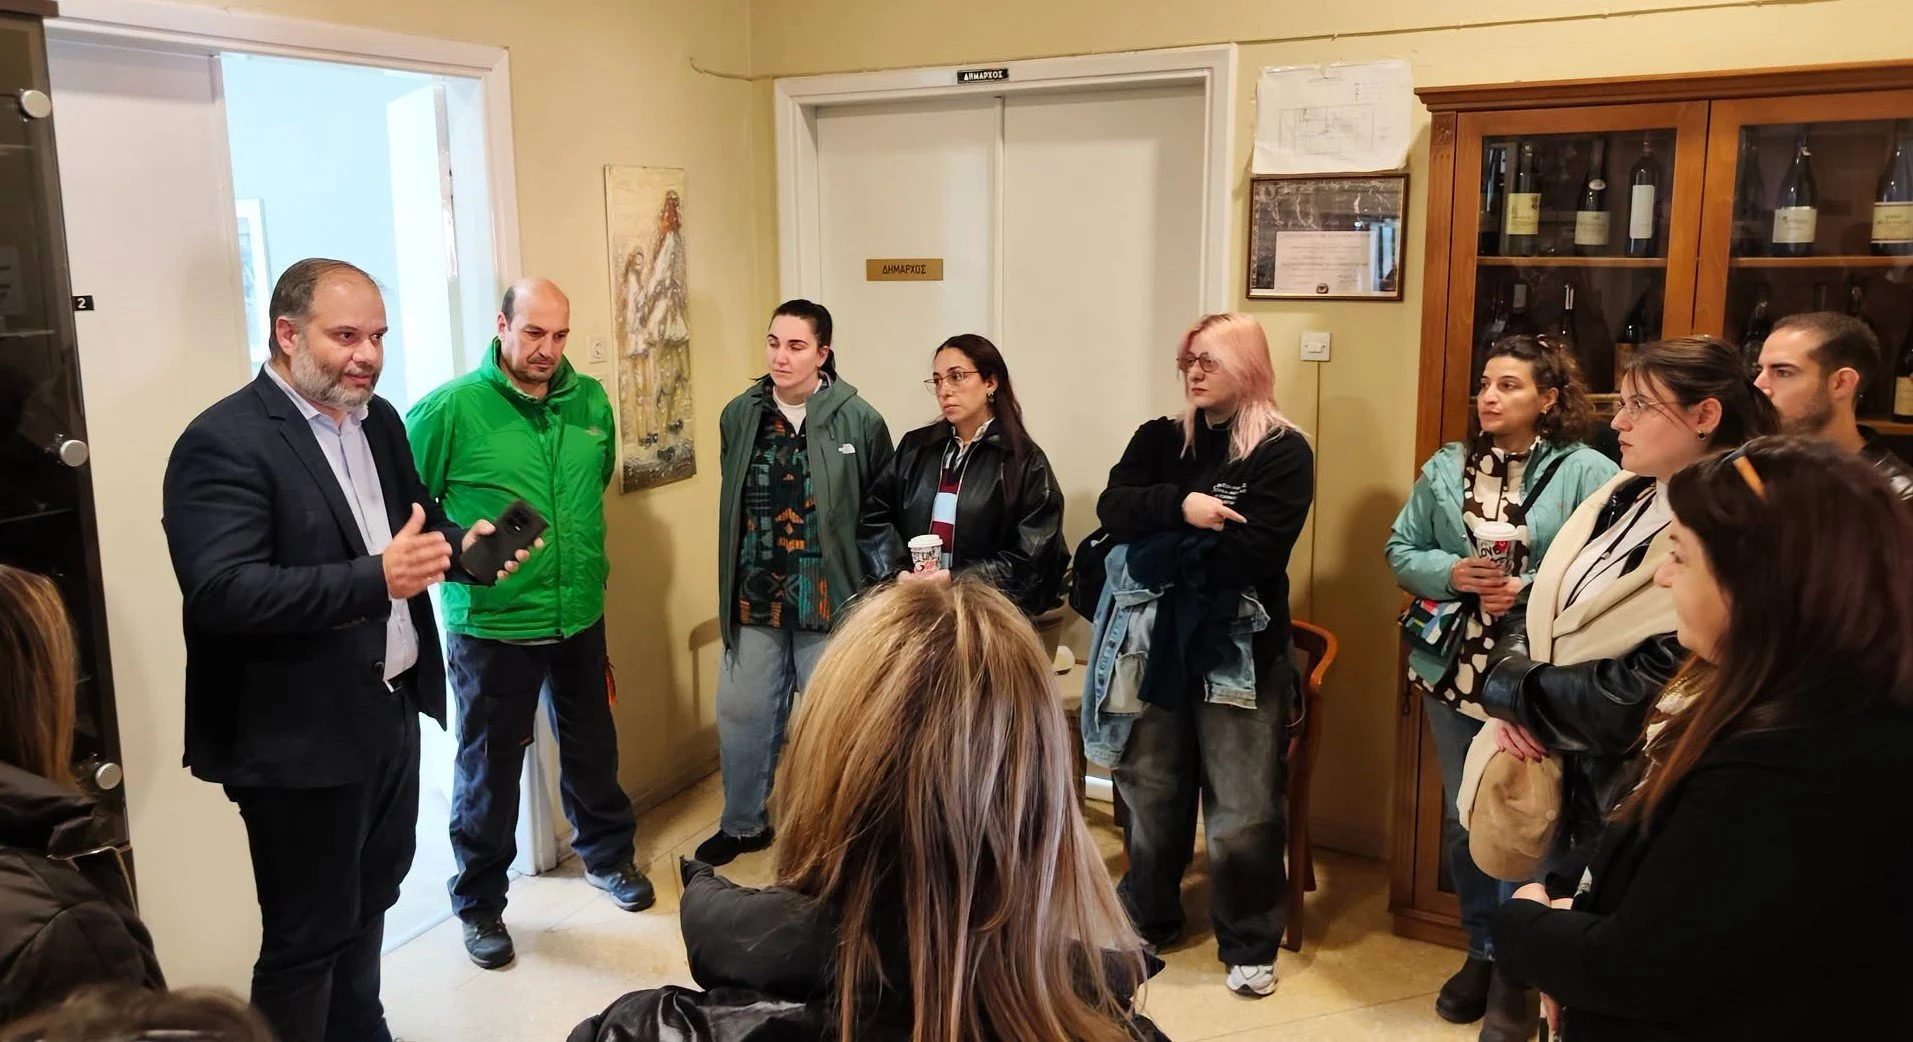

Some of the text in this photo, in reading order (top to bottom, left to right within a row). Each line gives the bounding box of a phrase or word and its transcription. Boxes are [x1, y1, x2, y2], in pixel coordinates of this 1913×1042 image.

[964, 71, 1003, 80] ΔΗΜΑΡΧΟΣ
[882, 264, 926, 274] ΔΗΜΑΡΧΟΣ
[77, 298, 86, 308] 2
